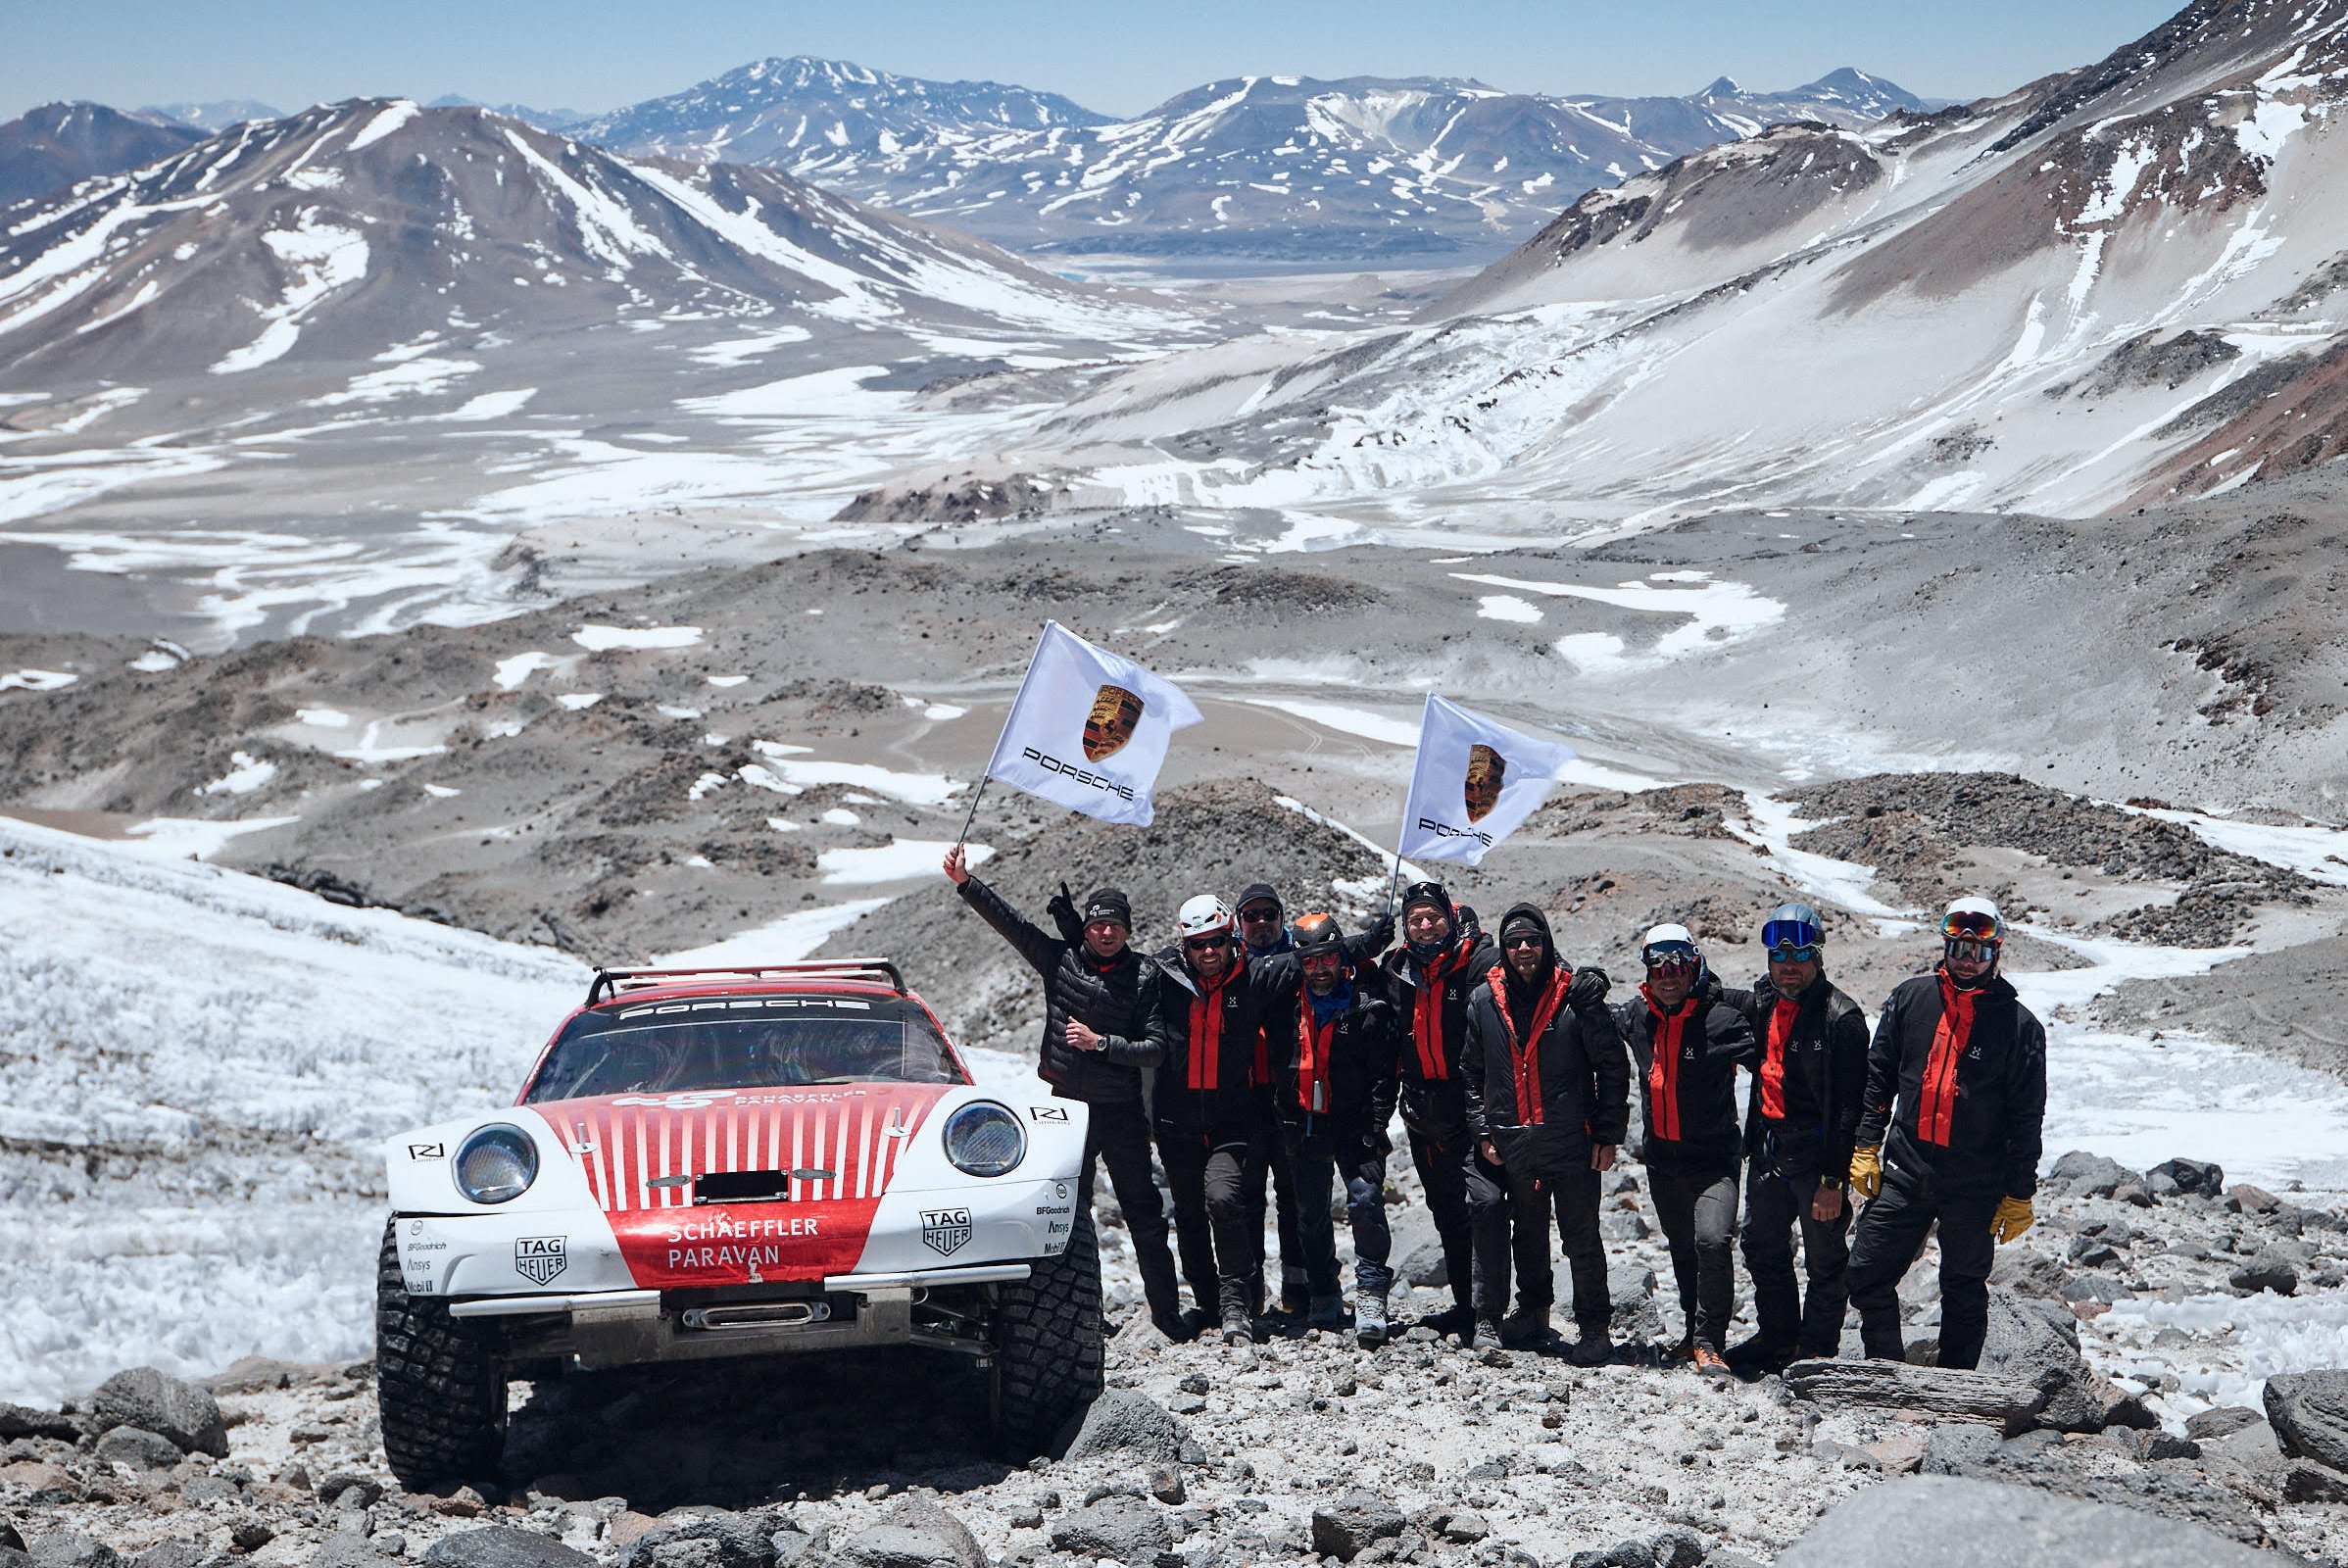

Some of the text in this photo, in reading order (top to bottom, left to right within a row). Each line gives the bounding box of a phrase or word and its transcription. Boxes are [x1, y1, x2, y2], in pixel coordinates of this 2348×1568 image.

[1022, 747, 1134, 802] PORSCHE
[1419, 817, 1493, 848] PORHE
[618, 1001, 871, 1020] PORSCHE
[925, 1211, 967, 1226] TAG
[1037, 1206, 1070, 1215] BFGoodrich
[668, 1218, 818, 1243] SCHAEFFLER
[1049, 1221, 1069, 1235] Ansys
[408, 1243, 447, 1251] BFGoodrich
[520, 1240, 561, 1254] TAG
[926, 1229, 969, 1252] HEUER
[408, 1258, 431, 1273] Ansys
[668, 1246, 779, 1268] PARAVAN
[519, 1258, 563, 1281] HEUER
[408, 1281, 425, 1293] Mobil
